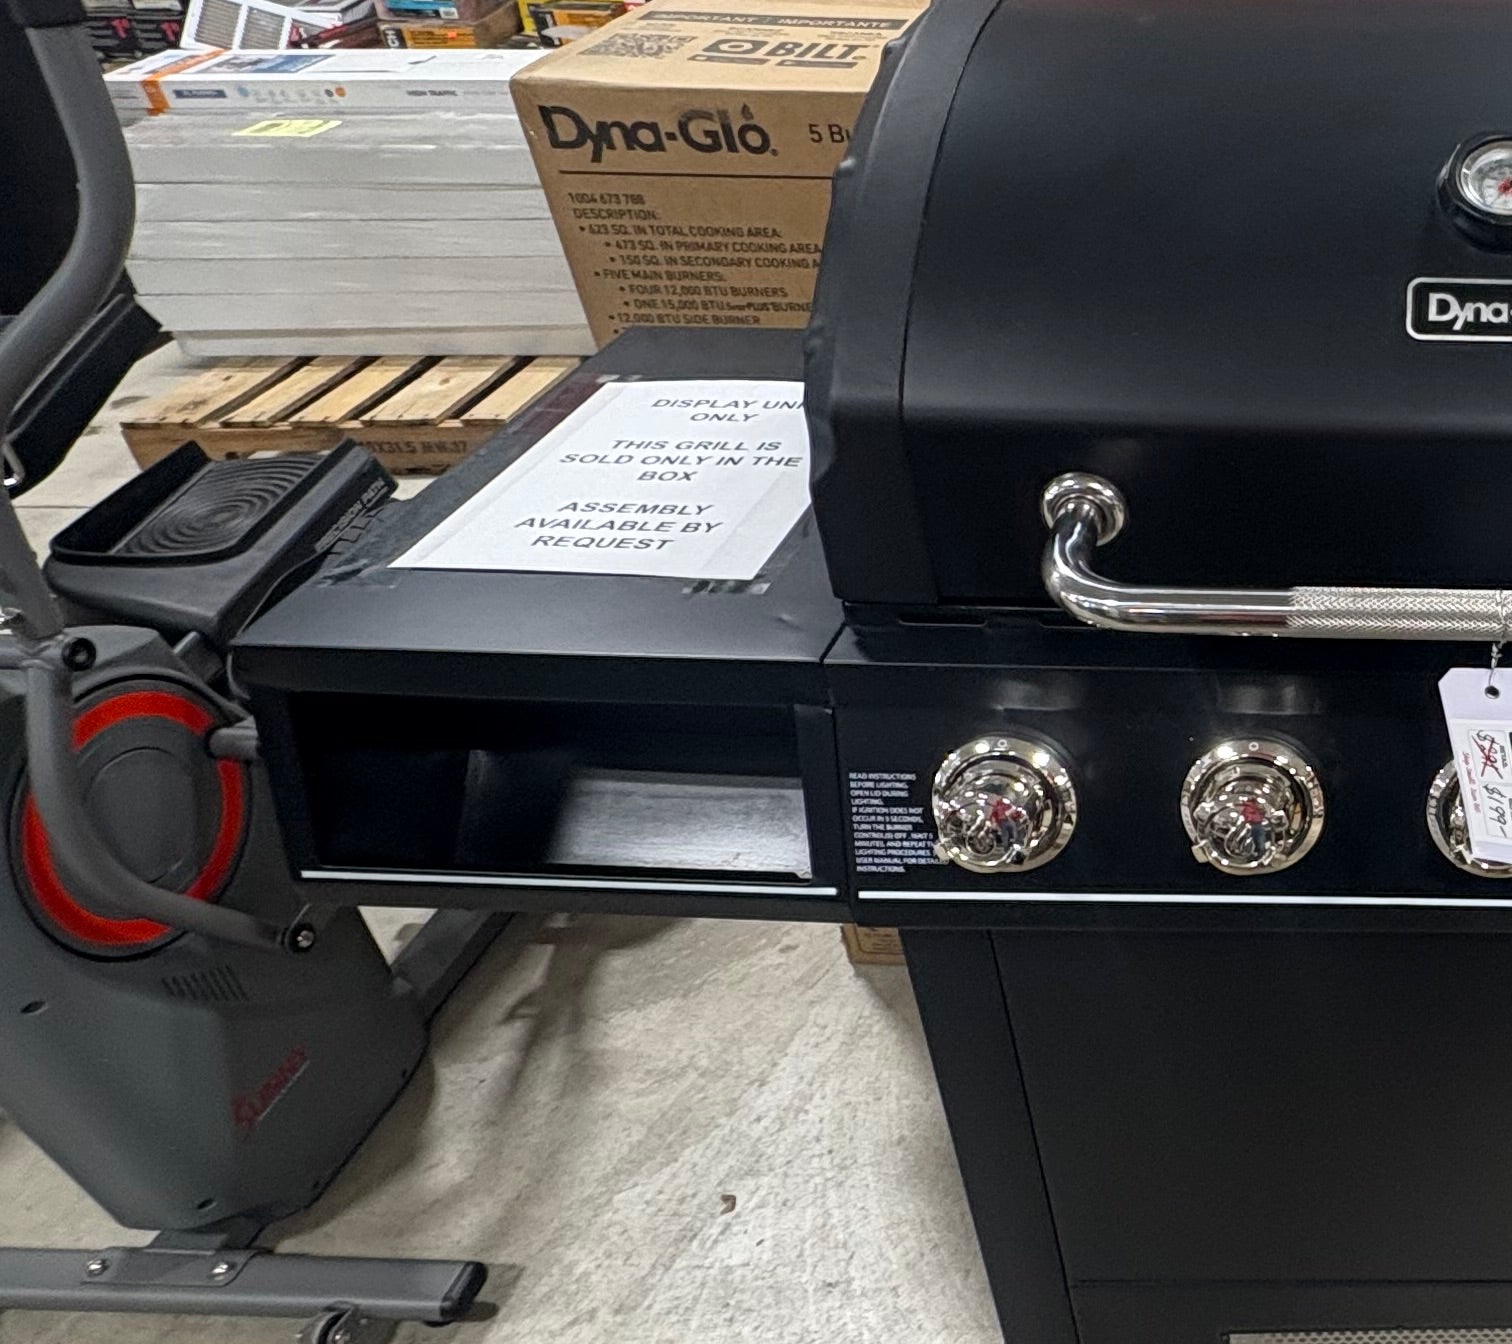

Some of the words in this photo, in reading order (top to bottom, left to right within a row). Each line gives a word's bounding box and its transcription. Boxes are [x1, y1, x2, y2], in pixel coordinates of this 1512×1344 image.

[654, 14, 756, 23] IMPORTANT
[777, 18, 891, 28] IMPORTANTE
[763, 42, 867, 60] BILT
[538, 105, 777, 164] Dyna-Glo
[809, 124, 823, 143] 5
[569, 192, 598, 204] 1004
[600, 193, 622, 205] 673
[573, 208, 658, 220] DESCRIPTION:
[634, 225, 646, 236] IN
[649, 225, 687, 236] TOTAL
[689, 226, 744, 238] COOKING
[676, 241, 731, 253] PRIMARY
[732, 242, 788, 254] COOKING
[680, 256, 752, 268] SECONDARY
[755, 258, 811, 269] COOKING
[603, 270, 630, 280] FIVE
[632, 271, 662, 281] MAIN
[628, 284, 661, 295] FOUR
[664, 285, 702, 297] 12,000
[704, 285, 728, 296] BTU
[731, 286, 789, 298] BURNERS
[633, 299, 659, 309] ONE
[700, 301, 726, 311] BTU
[656, 314, 680, 324] BTU
[683, 314, 712, 324] SIDE
[714, 315, 761, 326] BURNER
[651, 399, 756, 410] DISPLAY
[761, 400, 805, 411] UNI
[689, 412, 759, 423] ONLY
[610, 439, 675, 451] THIS
[679, 439, 748, 451] GRILL
[755, 440, 782, 452] IS
[559, 454, 634, 465] SOLD
[640, 455, 712, 466] ONLY
[713, 456, 743, 467] IN
[750, 456, 803, 468] THE
[636, 471, 697, 482] BOX
[557, 502, 714, 515] ASSEMBLY
[514, 518, 679, 533] AVAILABLE
[679, 521, 724, 534] BY
[530, 535, 675, 550] REQUEST
[1499, 745, 1508, 768] RETAIL
[849, 772, 868, 780] READ
[868, 773, 917, 781] INSTRUCTIONS
[850, 781, 875, 789] BEFORE
[853, 823, 871, 831] TURN
[872, 823, 885, 831] THE
